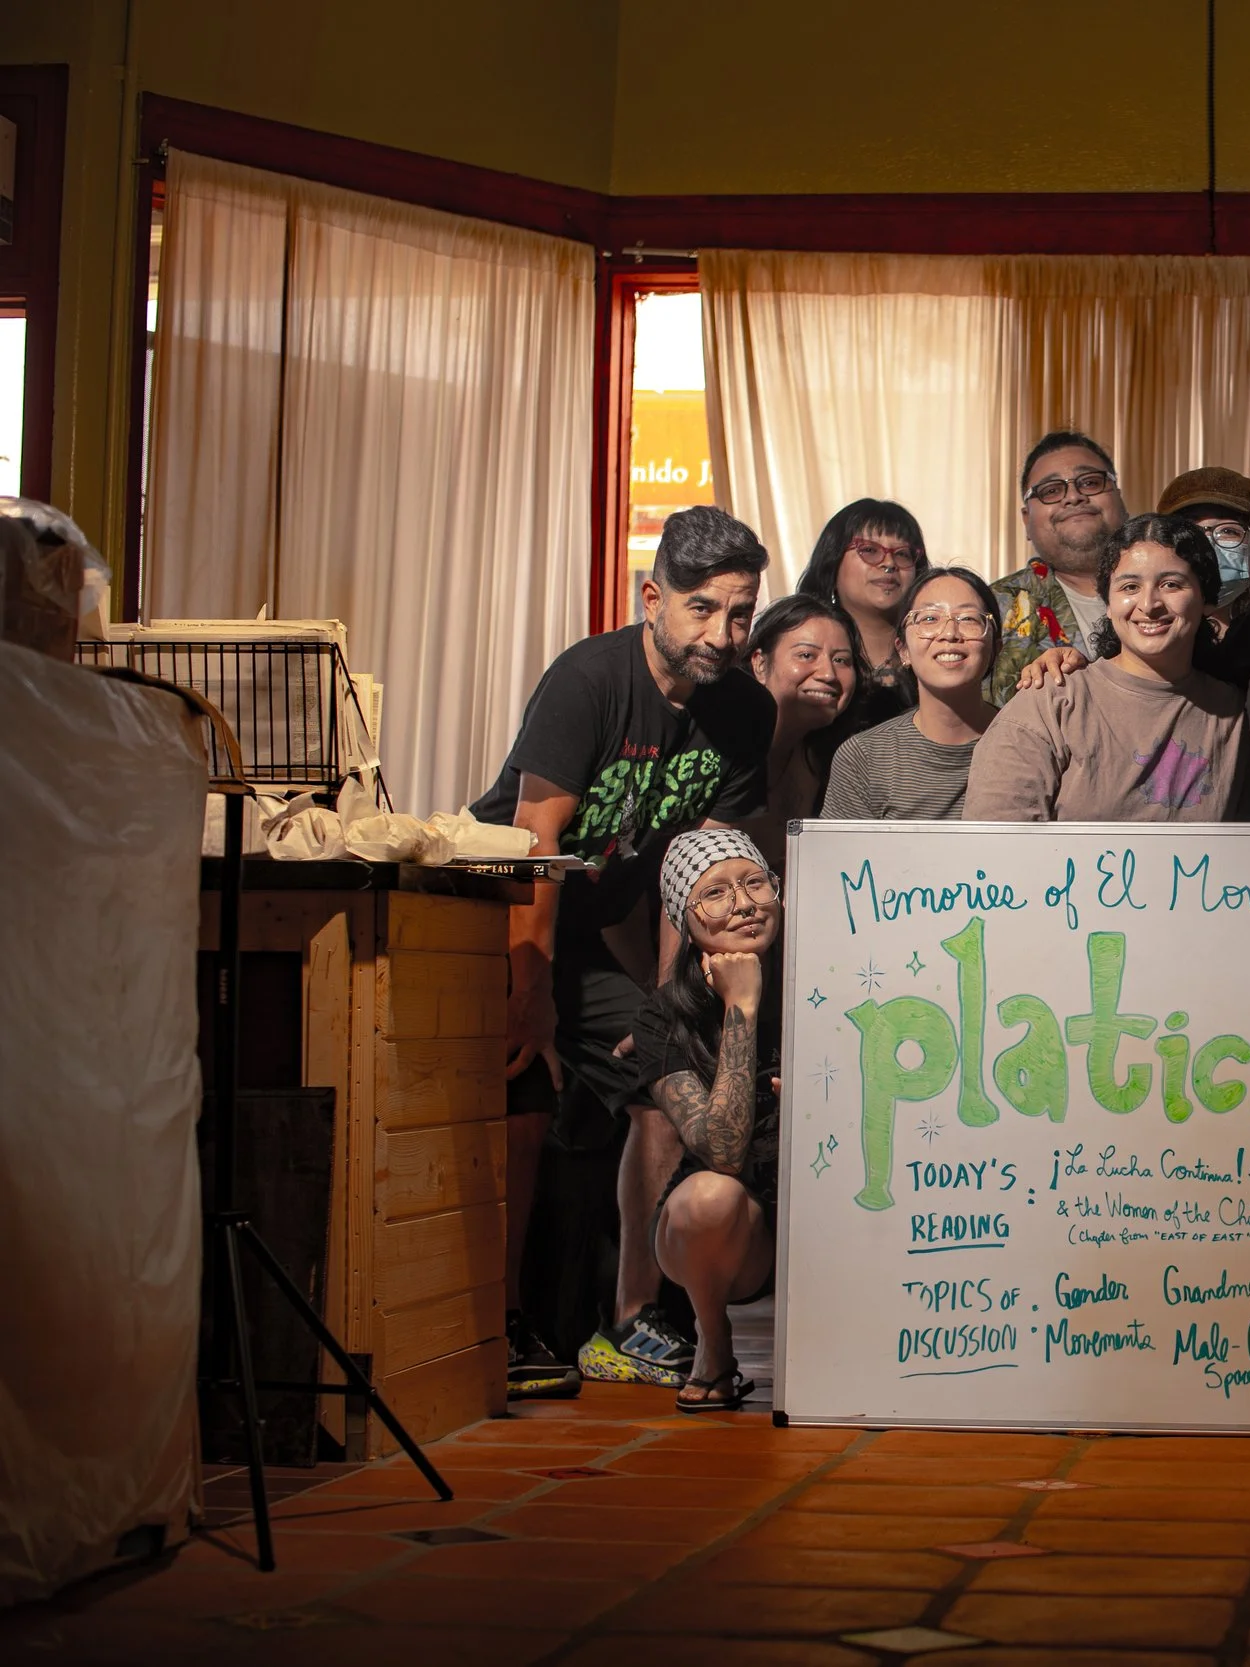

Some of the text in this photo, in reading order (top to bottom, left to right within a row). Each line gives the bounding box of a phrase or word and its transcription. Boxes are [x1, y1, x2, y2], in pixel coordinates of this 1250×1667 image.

[492, 864, 516, 874] EAST
[841, 859, 1028, 934] Memories
[1045, 857, 1078, 930] of
[1097, 849, 1147, 910] El
[906, 1157, 1017, 1192] TODAY'S
[1096, 1144, 1153, 1178] Lucha
[911, 1213, 1010, 1243] READING
[1056, 1200, 1069, 1218] &
[1075, 1196, 1102, 1218] the
[1105, 1191, 1158, 1221] Women
[1164, 1200, 1181, 1230] of
[1182, 1201, 1210, 1223] the
[1119, 1227, 1148, 1245] from
[1154, 1230, 1188, 1241] "EAST
[1192, 1232, 1207, 1242] OF
[902, 1278, 992, 1313] TOPICS
[1000, 1287, 1020, 1311] OF
[1055, 1271, 1129, 1310] Gender
[898, 1324, 1017, 1363] DISCUSSION
[1045, 1318, 1156, 1363] Movements
